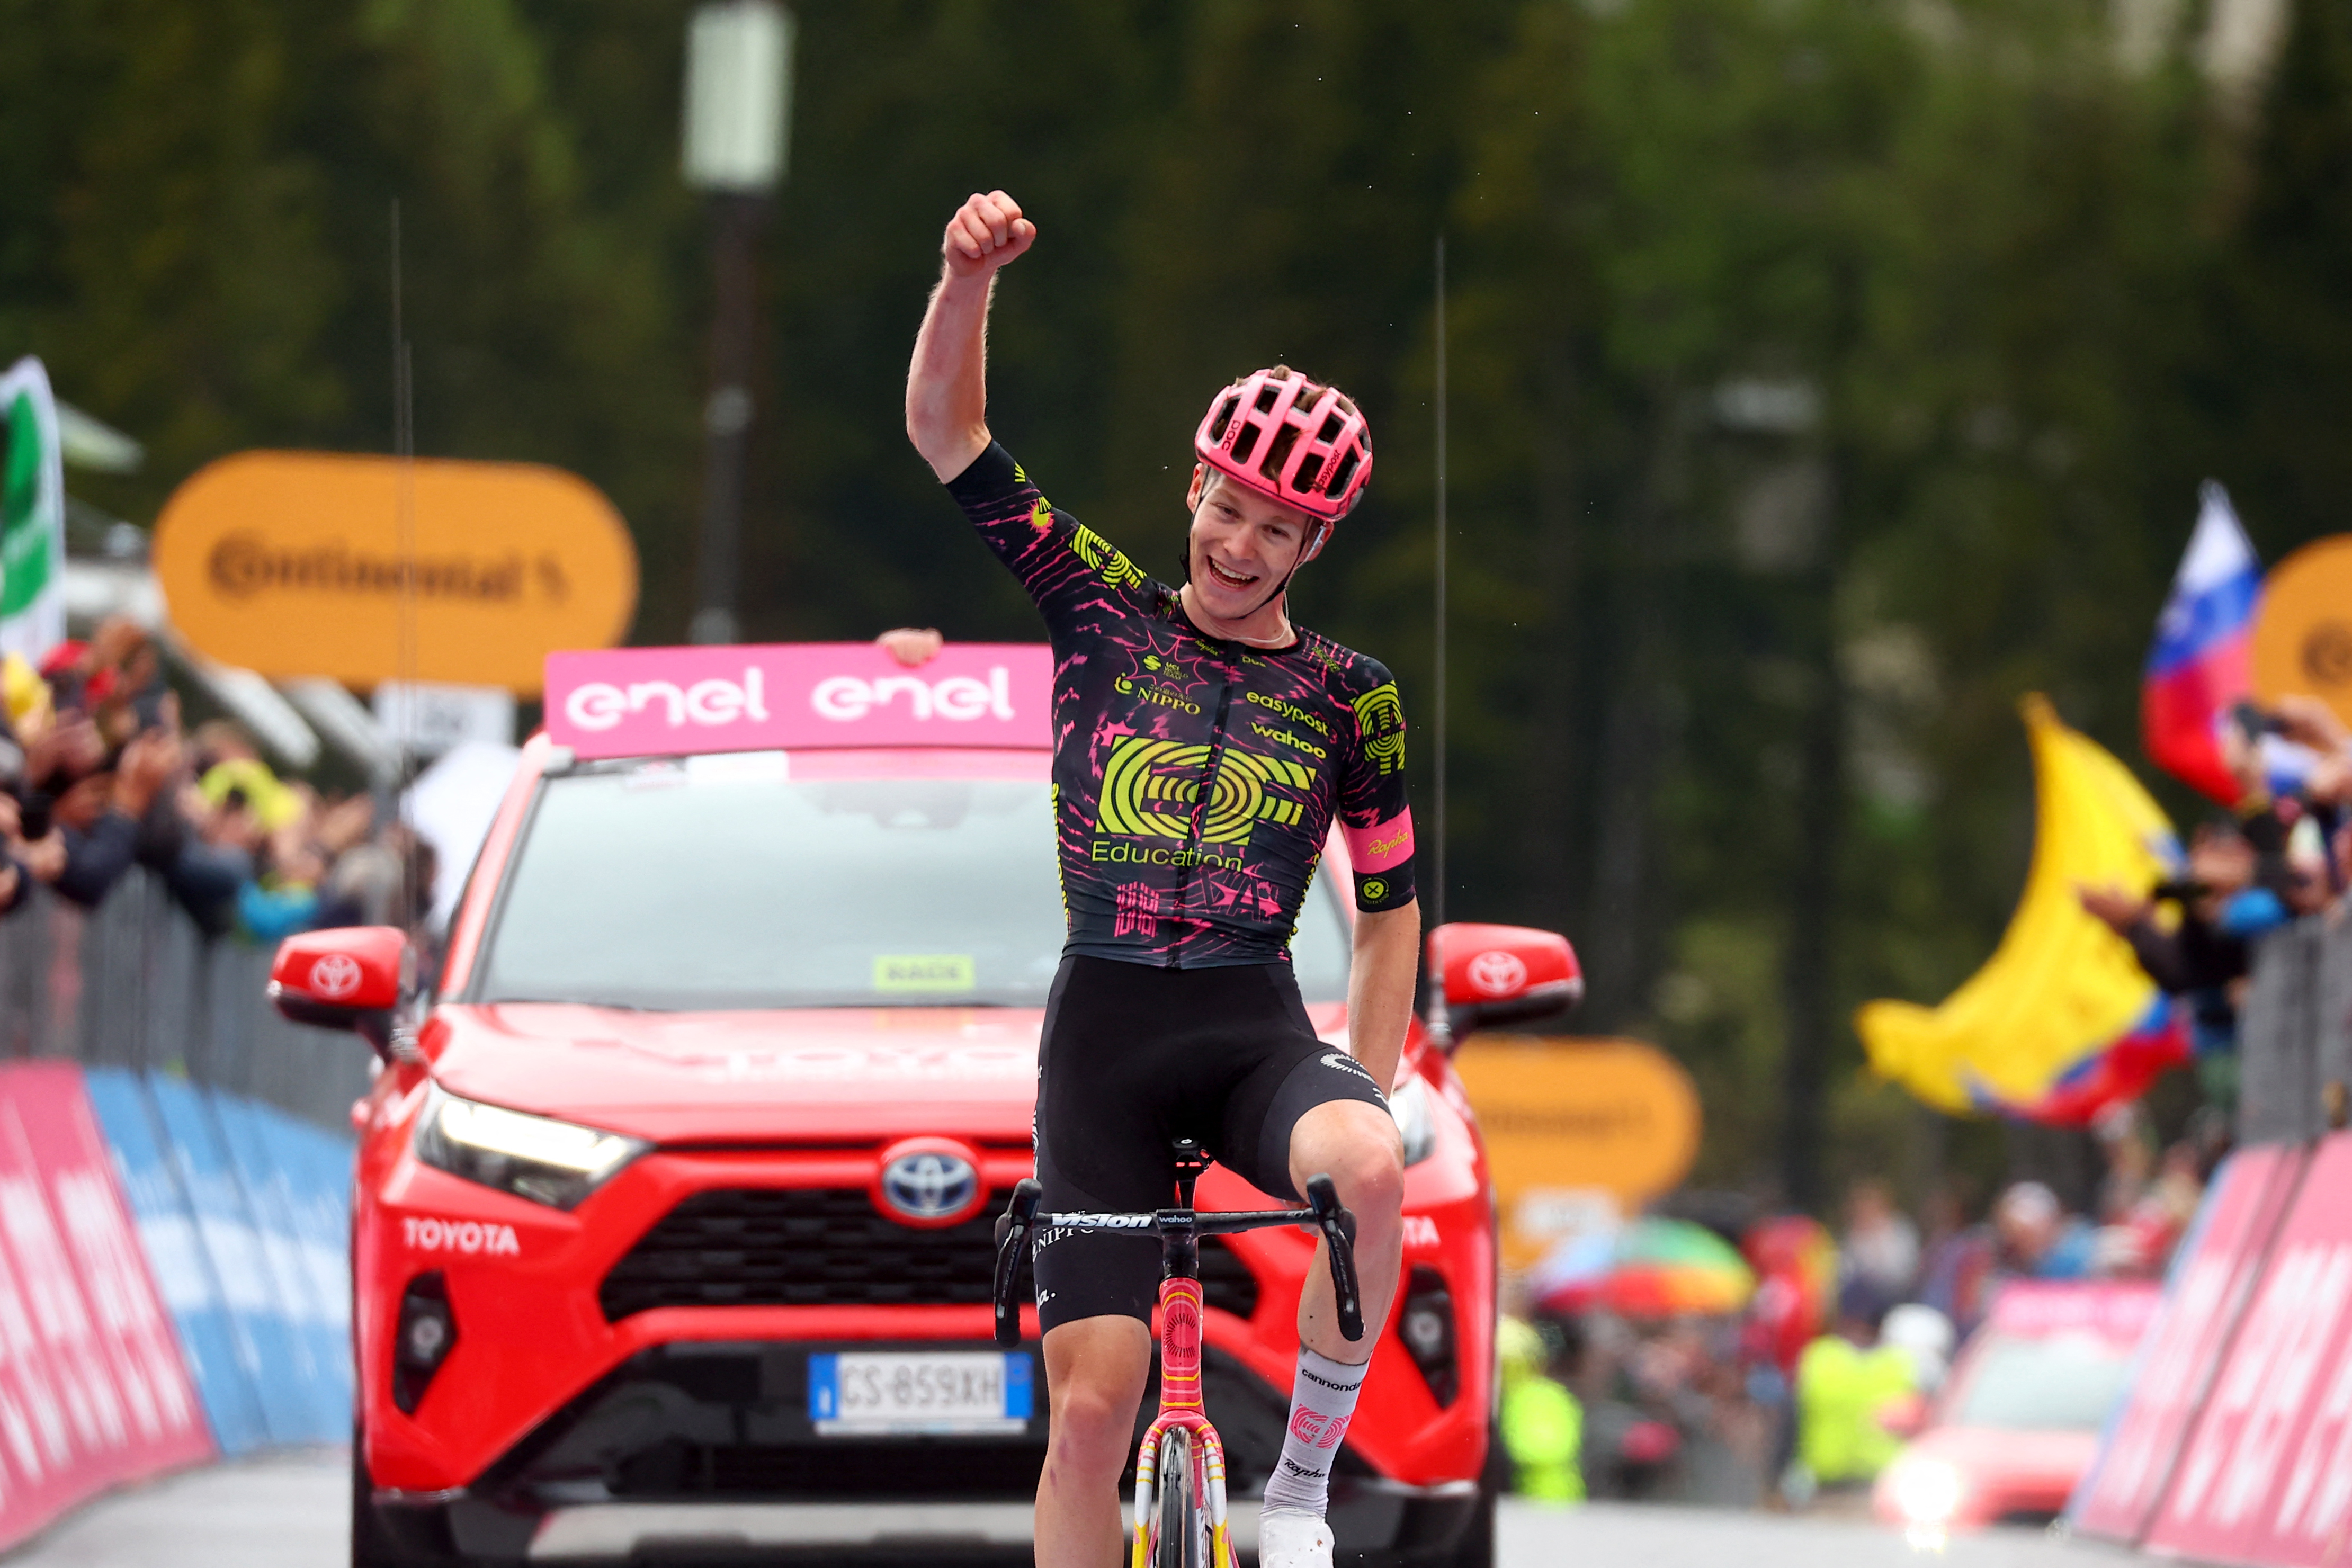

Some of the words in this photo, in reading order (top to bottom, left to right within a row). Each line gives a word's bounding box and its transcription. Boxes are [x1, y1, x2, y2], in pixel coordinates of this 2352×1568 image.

[1316, 450, 1341, 490] asypost
[1166, 661, 1180, 670] UCI
[566, 666, 769, 730] enel
[812, 666, 1015, 721] enel
[1137, 687, 1201, 715] NIPPO
[1246, 691, 1329, 737] easypost
[1251, 722, 1327, 759] wahoo
[1092, 840, 1243, 872] Education
[1367, 828, 1409, 858] Rapha
[1160, 1215, 1192, 1223] wahoo
[402, 1217, 520, 1256] TOYOTA
[1302, 1369, 1363, 1391] cannonda
